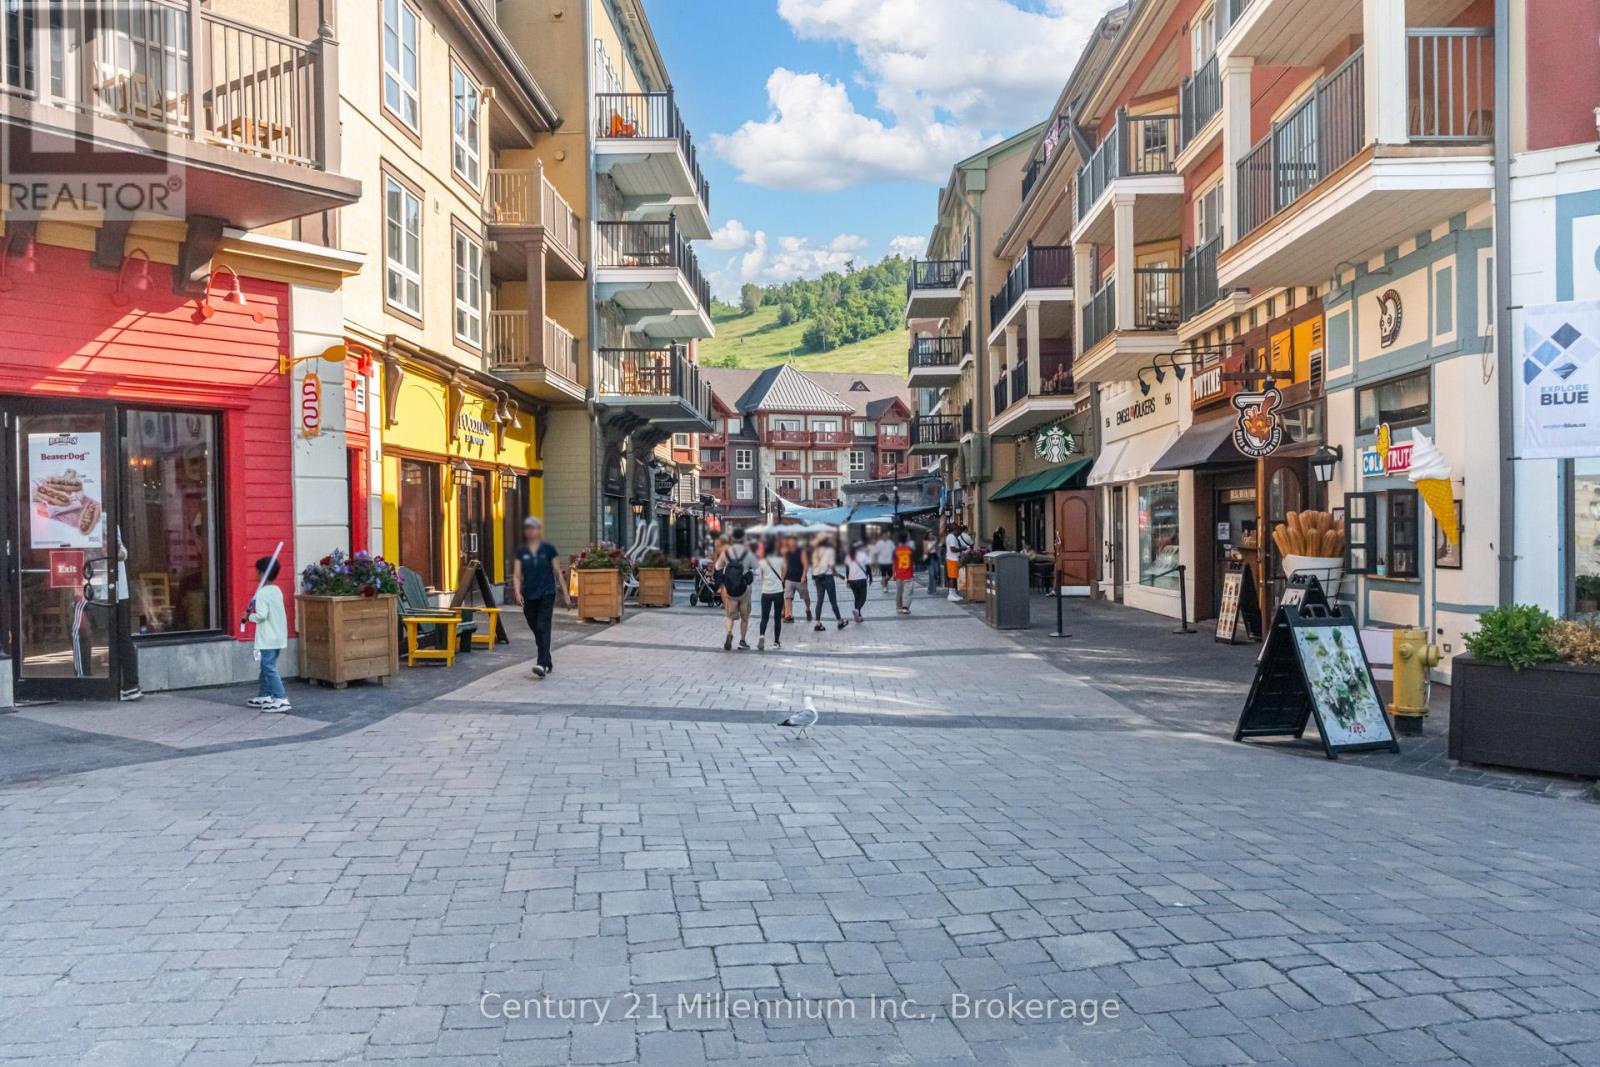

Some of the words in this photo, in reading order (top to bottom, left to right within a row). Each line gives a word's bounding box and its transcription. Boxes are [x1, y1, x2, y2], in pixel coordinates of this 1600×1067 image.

[1540, 384, 1589, 394] EXPLORE
[1540, 391, 1589, 406] BLUE
[1243, 446, 1258, 456] WITH
[1259, 444, 1273, 456] YOUR
[1271, 429, 1280, 446] FRIES
[58, 564, 77, 573] Exit
